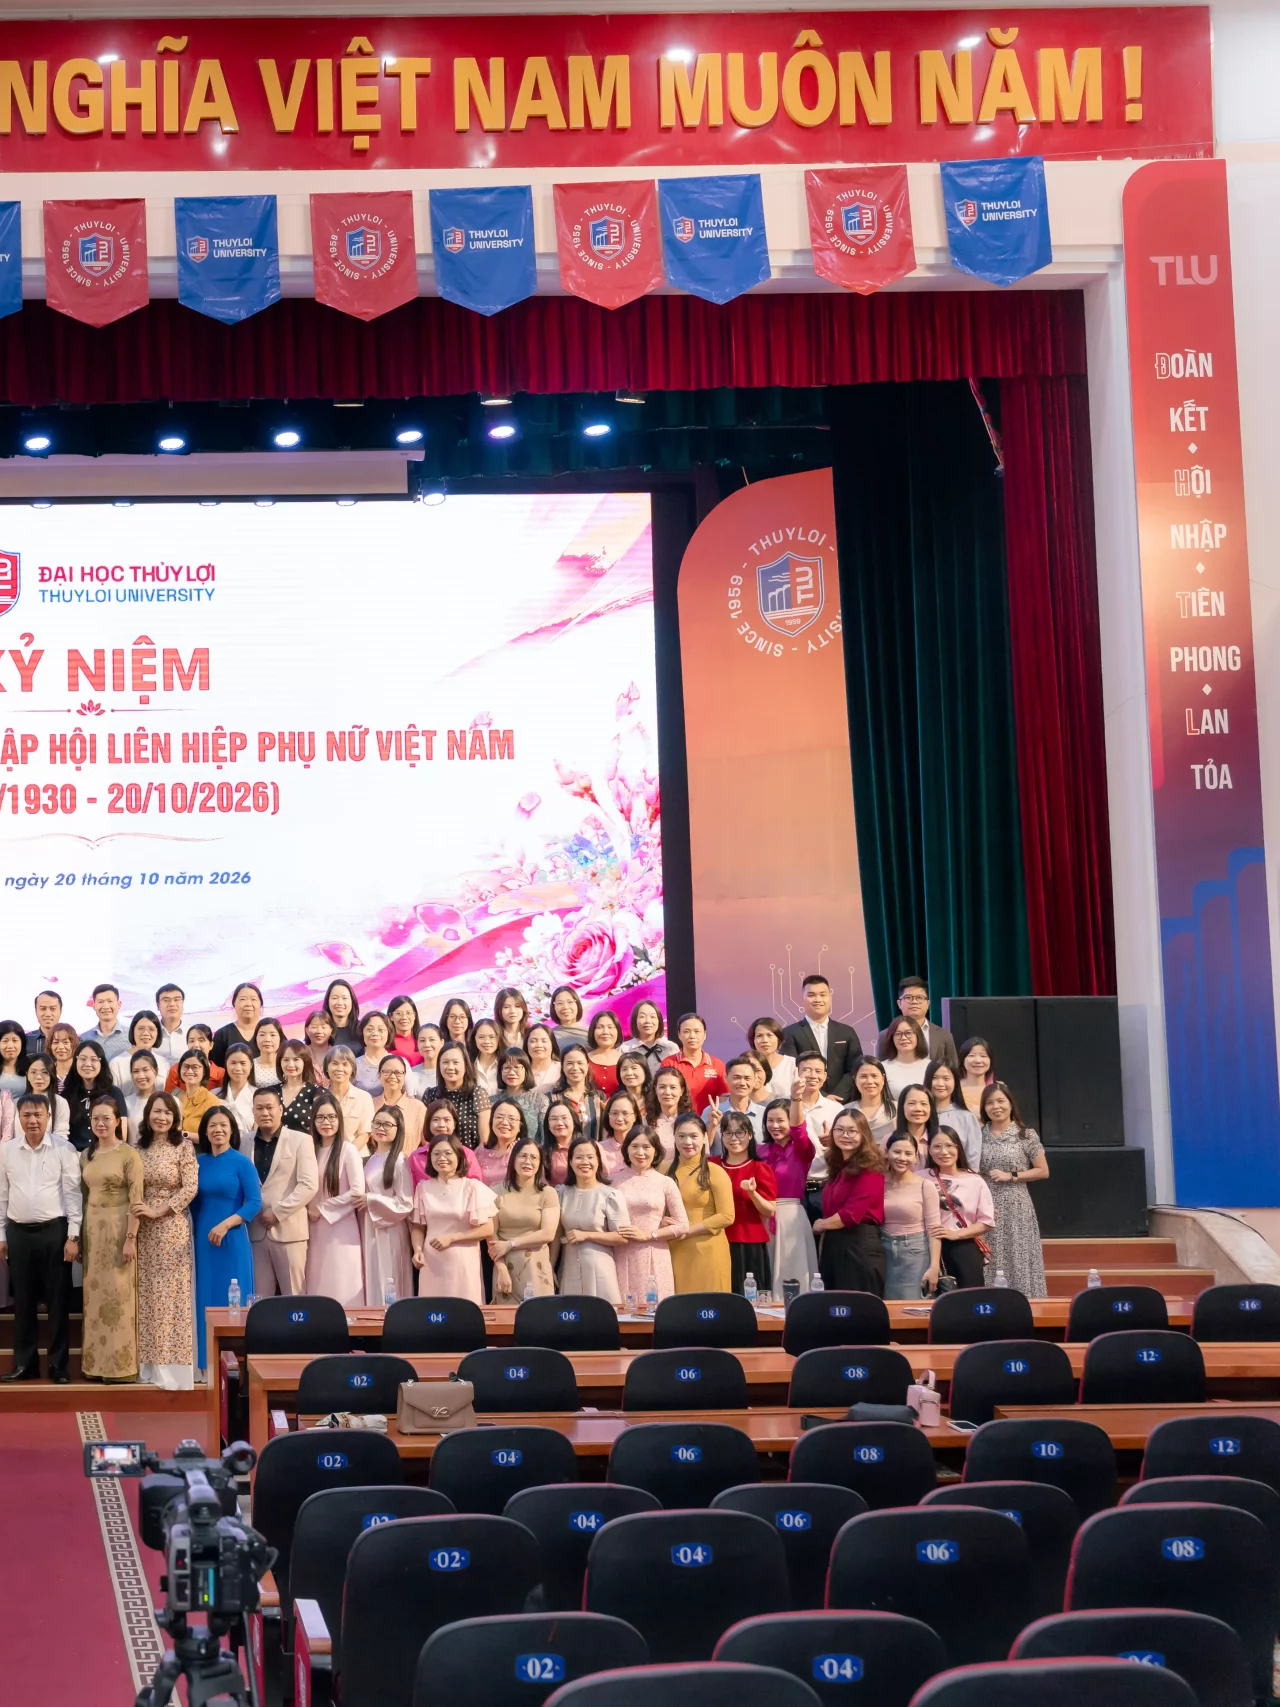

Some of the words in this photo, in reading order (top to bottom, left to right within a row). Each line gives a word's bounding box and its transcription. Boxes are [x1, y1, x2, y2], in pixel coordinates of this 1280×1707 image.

[258, 37, 432, 150] VIỆT
[453, 54, 631, 131] NAM
[658, 29, 893, 128] MUÔN
[981, 200, 1021, 211] THUYLOI
[698, 218, 738, 228] THUYLOI
[982, 209, 1038, 221] UNIVERSITY
[469, 229, 509, 239] THUYLOI
[700, 227, 754, 238] UNIVERSITY
[213, 238, 253, 248] THUYLOI
[470, 238, 524, 249] UNIVERSITY
[213, 248, 267, 258] UNIVERSITY
[1149, 255, 1219, 286] TLU
[1155, 349, 1213, 380] ĐOÀN
[1169, 399, 1209, 432] KẾT
[1174, 465, 1212, 499] HỘI
[748, 527, 827, 556] THUYLOI
[1170, 520, 1228, 554] NHẬP
[38, 566, 73, 586] ĐẠI
[81, 566, 124, 586] HỌC
[129, 561, 183, 582] THỦY
[186, 563, 216, 586] LỢI
[39, 589, 112, 603] THUYLOI
[116, 588, 216, 603] UNIVERSITY
[727, 575, 743, 619] 1959
[1176, 586, 1226, 618] TIÊN
[736, 621, 784, 657] SINCE
[1169, 645, 1242, 673] PHONG
[67, 635, 210, 706] NIỆM
[1186, 708, 1229, 736] LAN
[49, 727, 97, 772] HỘI
[107, 726, 172, 765] LIÊN
[181, 725, 248, 770] HIỆP
[257, 731, 316, 769] PHỤ
[326, 724, 369, 762] NỮ
[375, 724, 437, 768] VIỆT
[1191, 757, 1233, 790] TỎA
[107, 781, 280, 816] 20/10/2026)
[4, 873, 48, 892] ngày
[55, 873, 77, 886] 20
[81, 871, 133, 890] tháng
[139, 872, 160, 886] 10
[164, 870, 204, 885] năm
[209, 871, 252, 885] 2026
[678, 1447, 695, 1461] 06
[860, 1448, 878, 1461] 08
[1041, 1443, 1058, 1456] 10
[1219, 1441, 1235, 1453] 12
[323, 1455, 341, 1468] 02
[498, 1451, 516, 1464] 04
[577, 1514, 596, 1529] 04
[783, 1513, 804, 1528] 06
[679, 1546, 704, 1564] 04
[926, 1543, 950, 1561] 06
[1172, 1540, 1195, 1557] 08
[437, 1551, 461, 1568] 02
[527, 1658, 554, 1679] 02
[820, 1658, 853, 1679] 04
